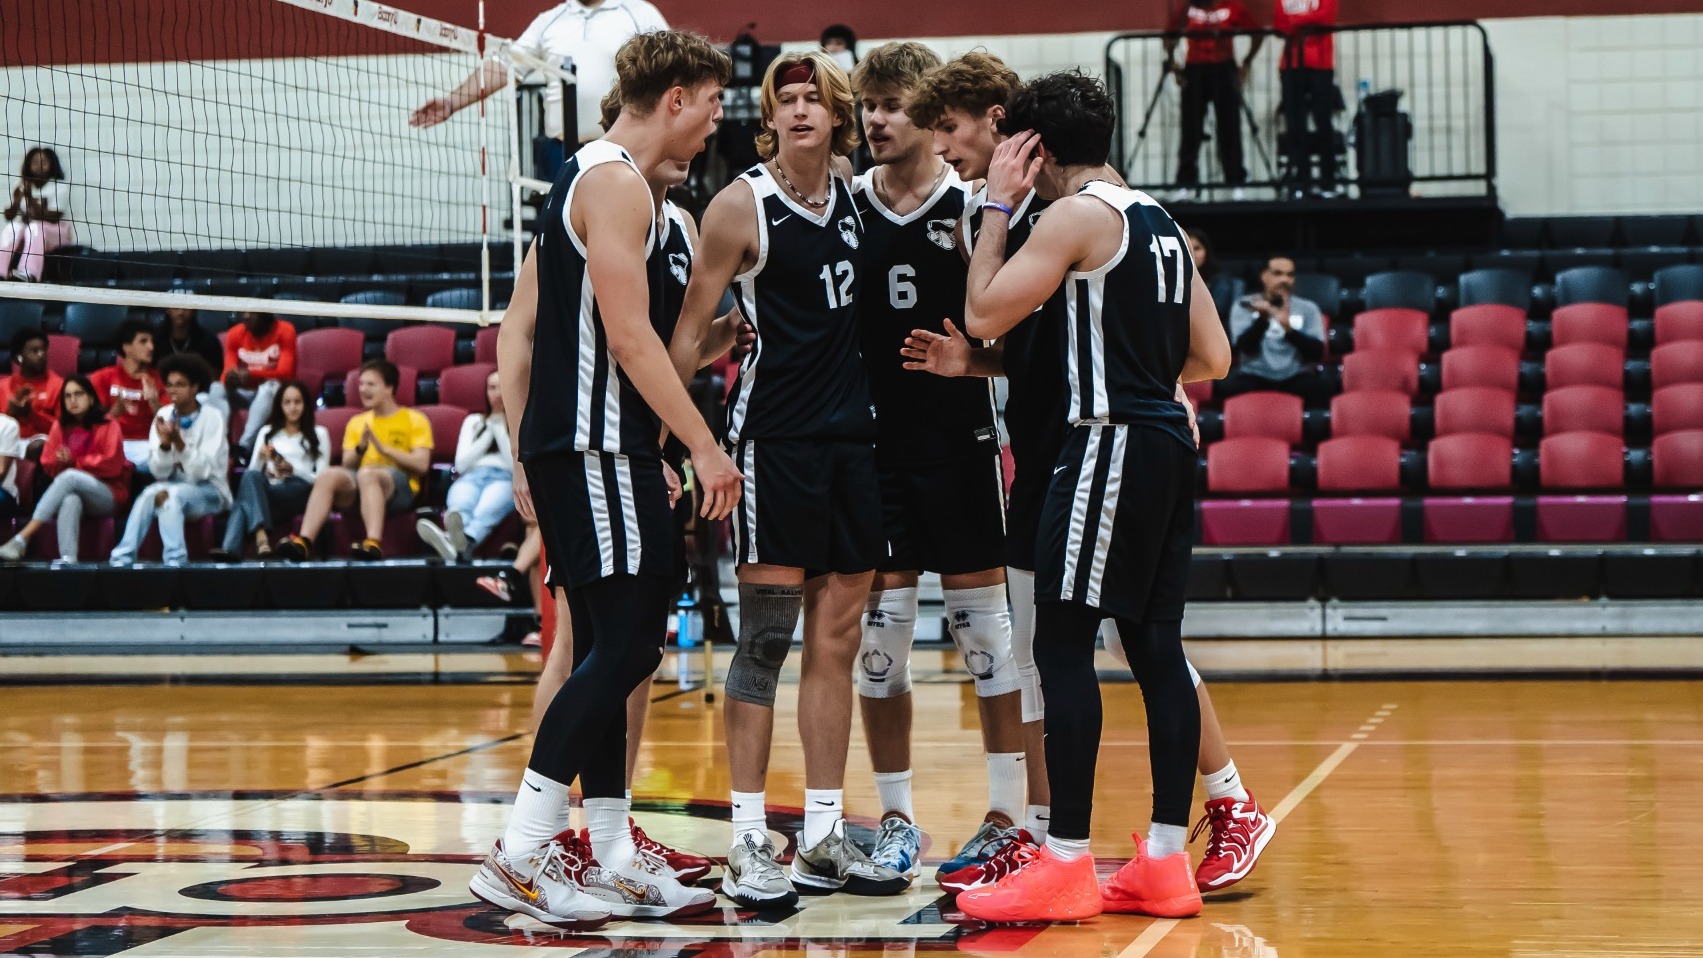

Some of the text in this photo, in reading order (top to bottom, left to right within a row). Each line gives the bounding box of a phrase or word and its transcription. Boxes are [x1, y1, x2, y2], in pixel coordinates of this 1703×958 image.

[819, 260, 855, 309] 12
[888, 264, 918, 309] 6
[1149, 233, 1184, 304] 17
